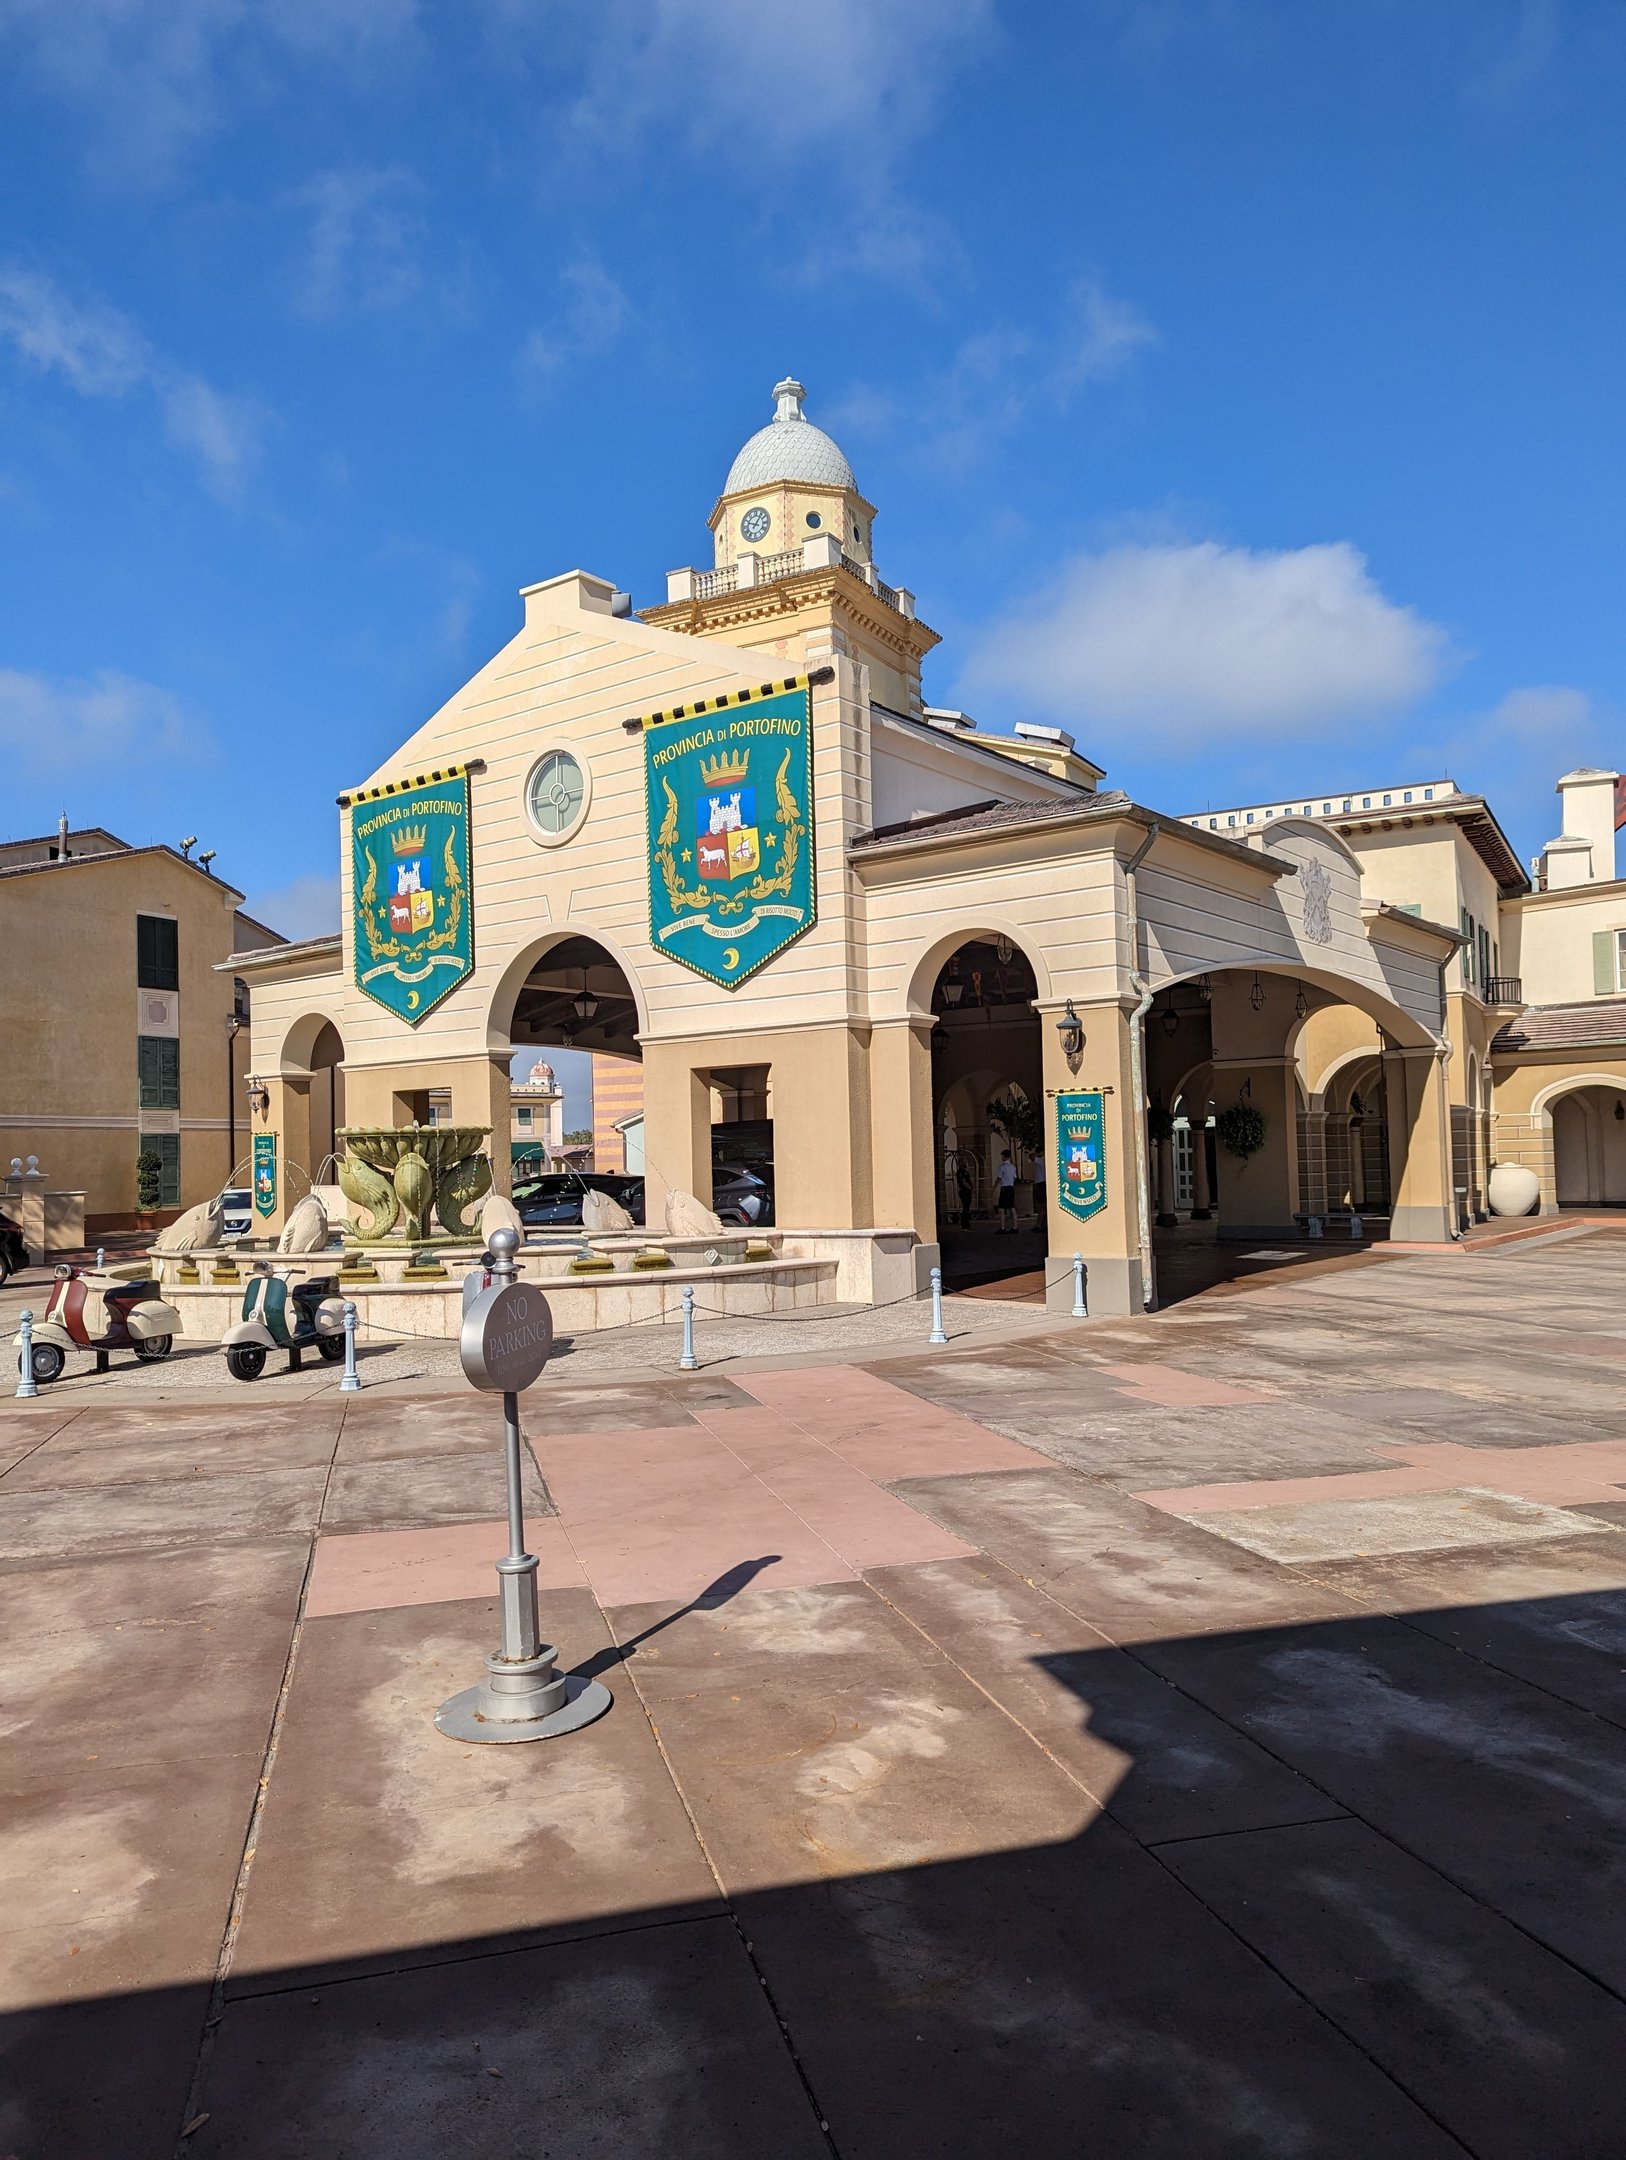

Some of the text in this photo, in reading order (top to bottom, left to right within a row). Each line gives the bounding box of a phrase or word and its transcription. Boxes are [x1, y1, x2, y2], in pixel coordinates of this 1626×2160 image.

[652, 728, 714, 769] PROVINCIA
[729, 718, 801, 739] PORTOFINO
[357, 807, 402, 839] PROVINCIA
[411, 800, 463, 816] PORTOFINO
[670, 917, 696, 932] VIVE BENE
[711, 922, 751, 937] SPESSO L'AMORE
[1061, 1113, 1098, 1121] PORTOFINO
[1068, 1194, 1097, 1204] BENVENUTO
[506, 1296, 528, 1325] NO
[489, 1319, 546, 1360] PARKING
